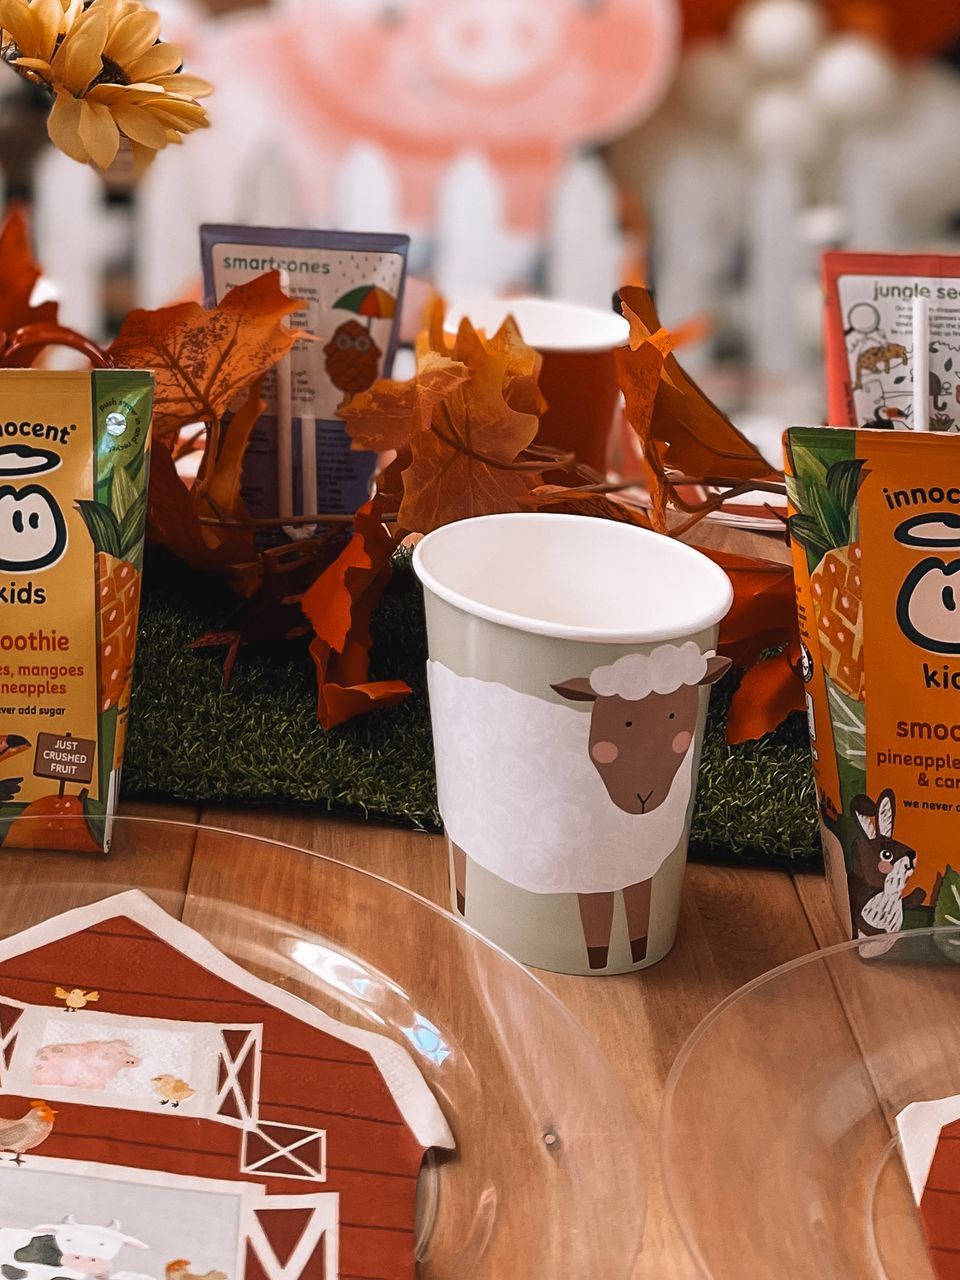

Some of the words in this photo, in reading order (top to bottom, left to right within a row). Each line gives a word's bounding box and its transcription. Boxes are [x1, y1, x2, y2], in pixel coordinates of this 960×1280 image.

[873, 282, 931, 302] jungle
[936, 287, 960, 300] se
[99, 397, 117, 411] push
[18, 666, 84, 679] mangoes
[18, 706, 36, 715] add
[39, 707, 66, 717] sugar
[54, 740, 78, 751] JUST
[43, 750, 87, 764] CRUSHED
[877, 748, 960, 771] pineapple
[50, 763, 77, 774] FRUIT
[917, 772, 929, 787] &
[903, 800, 919, 808] we
[922, 801, 953, 811] never
